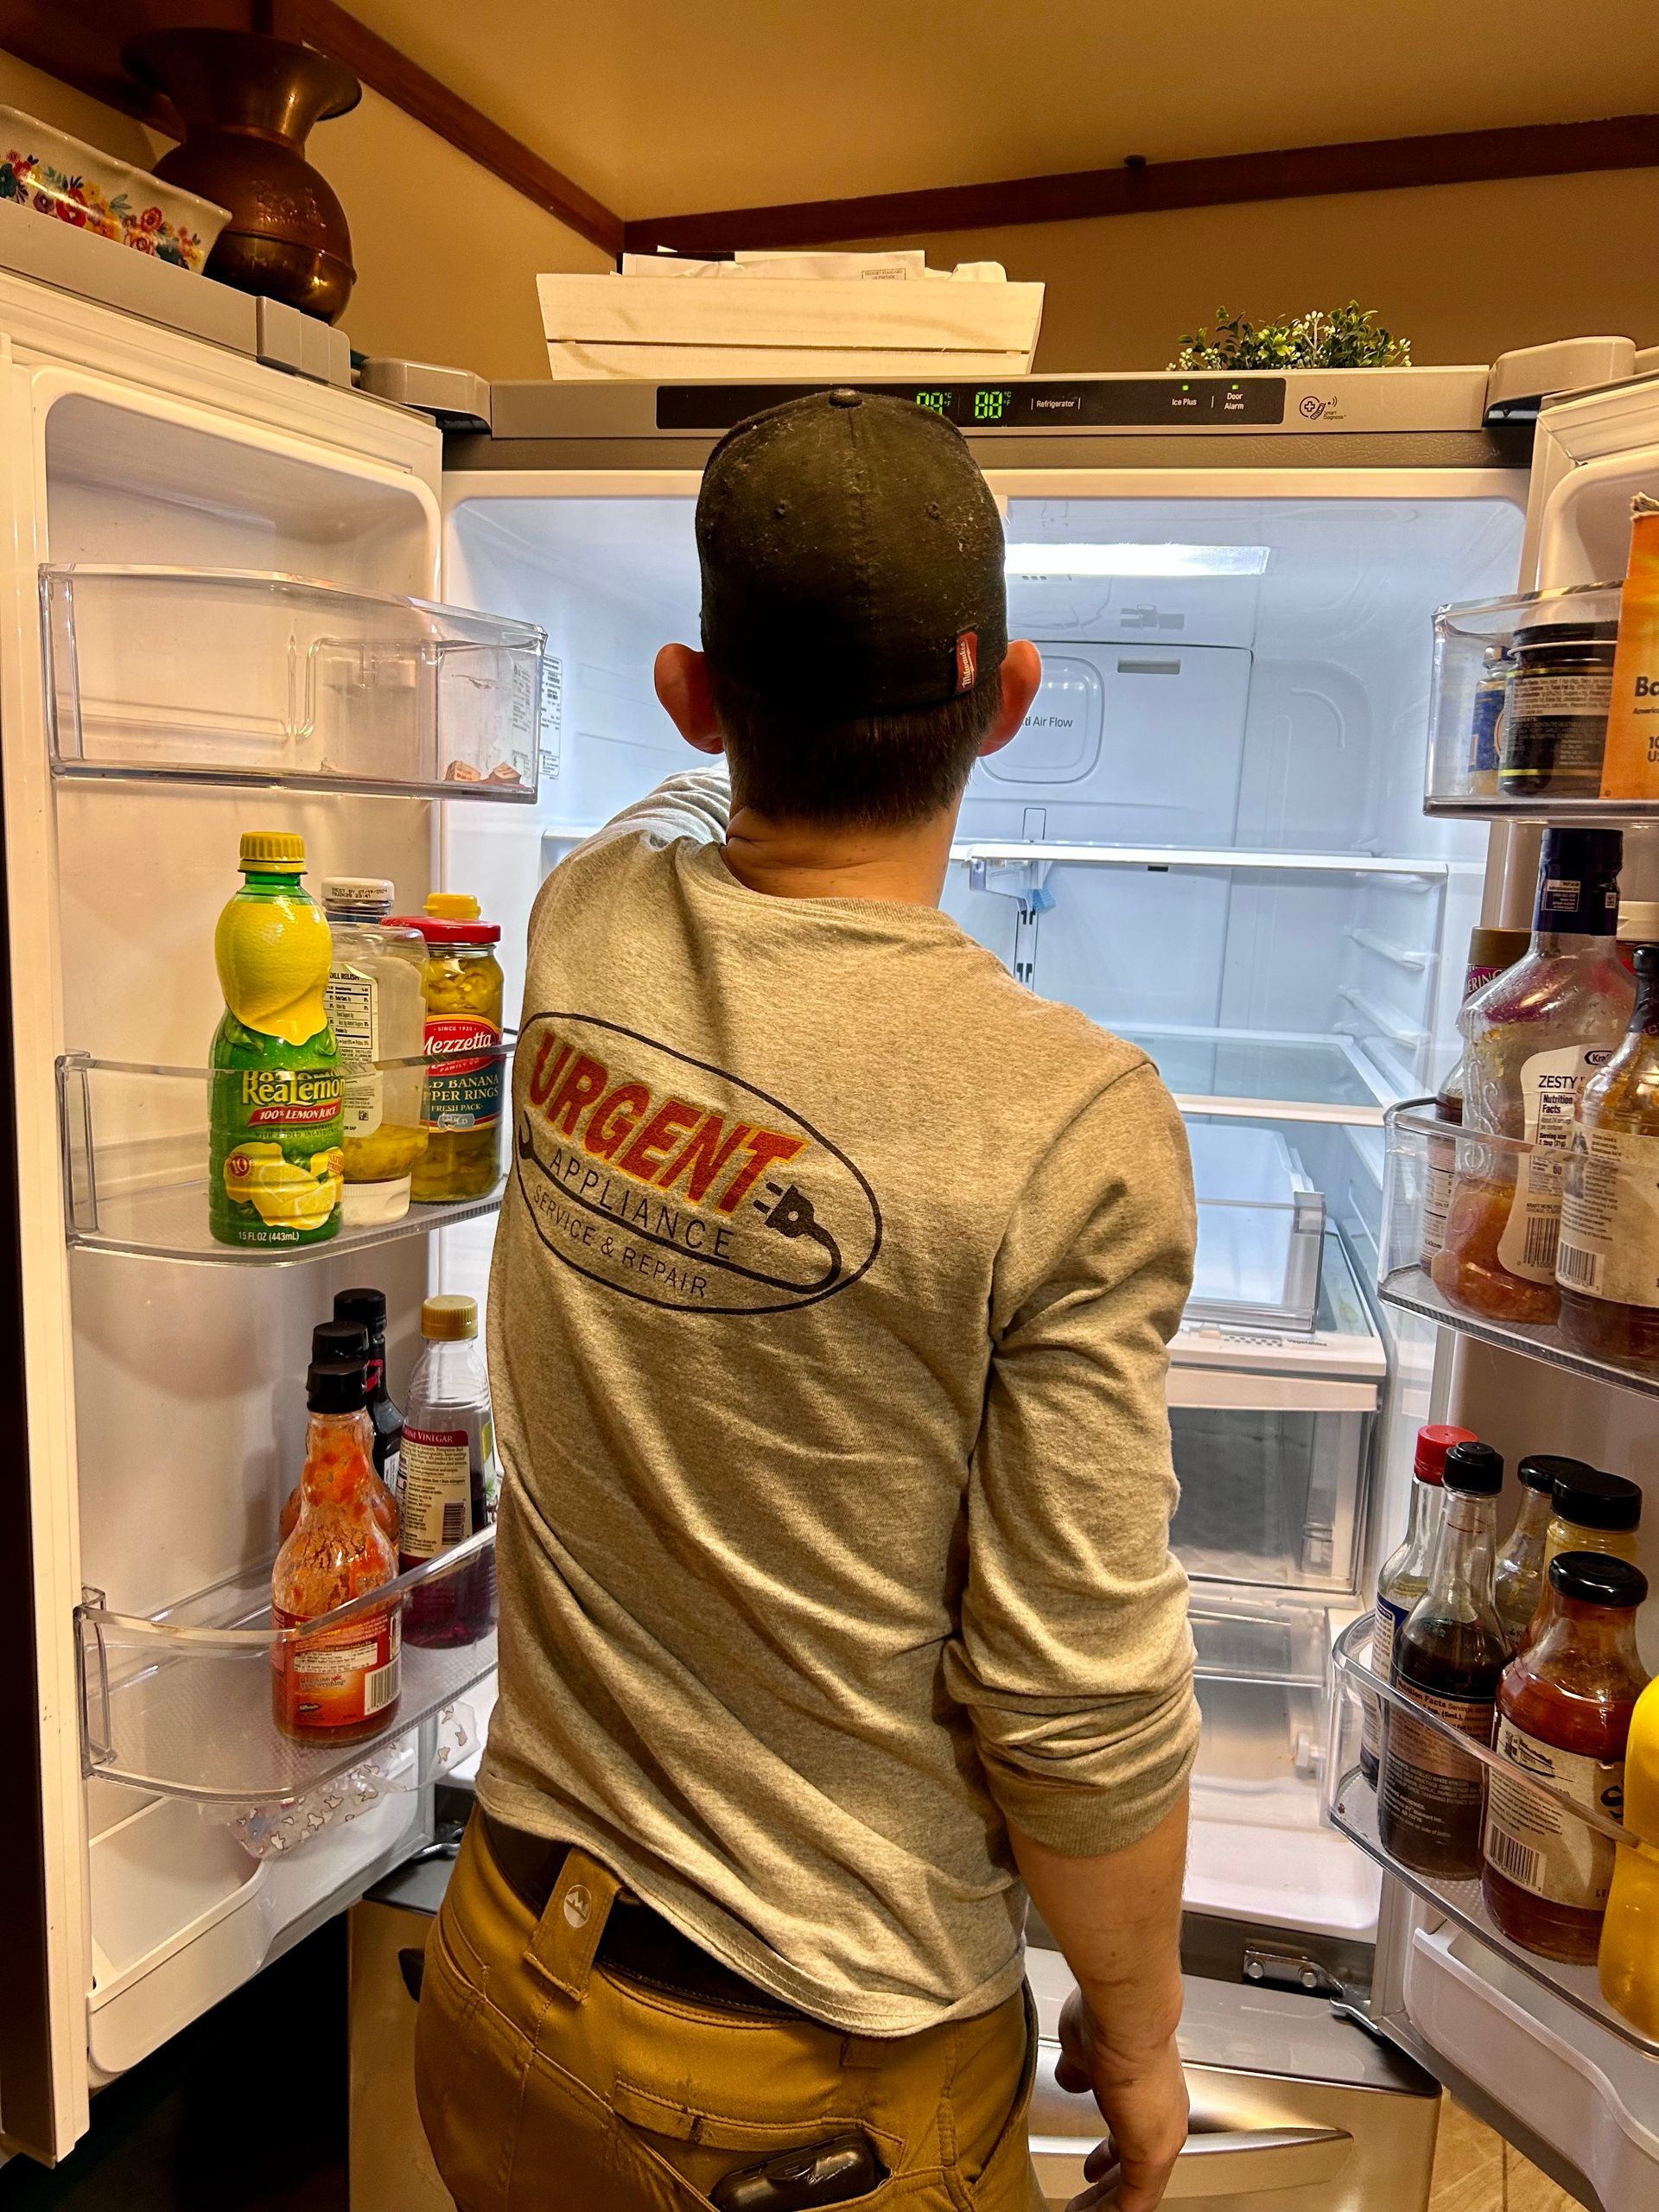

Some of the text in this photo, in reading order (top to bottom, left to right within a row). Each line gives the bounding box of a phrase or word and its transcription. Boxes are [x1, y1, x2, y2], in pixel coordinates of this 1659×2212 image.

[975, 391, 1002, 419] 88
[1036, 400, 1076, 409] Refrigerator
[960, 641, 971, 690] Milwaukee
[1033, 717, 1047, 726] Air
[1049, 717, 1073, 728] Flow
[242, 1071, 346, 1106] ReaLemon
[448, 1074, 499, 1089] BANANA
[1538, 1076, 1578, 1089] ZESTY
[464, 1087, 499, 1101] RINGS
[1543, 1094, 1573, 1104] Nutrition
[260, 1105, 337, 1120] 100% LEMON JUICE
[1542, 1104, 1561, 1114] Facts
[529, 1032, 810, 1219] URGENT
[1539, 1132, 1557, 1141] Serving
[231, 1158, 250, 1174] 10
[550, 1147, 734, 1260] APPLIANCE
[238, 1231, 300, 1243] 15 FL OZ (443mL)
[533, 1185, 707, 1298] SERVICE & REPAIR
[1287, 1338, 1327, 1347] Vegetables
[417, 1431, 454, 1444] VINEGAR
[1424, 1694, 1446, 1708] Facts
